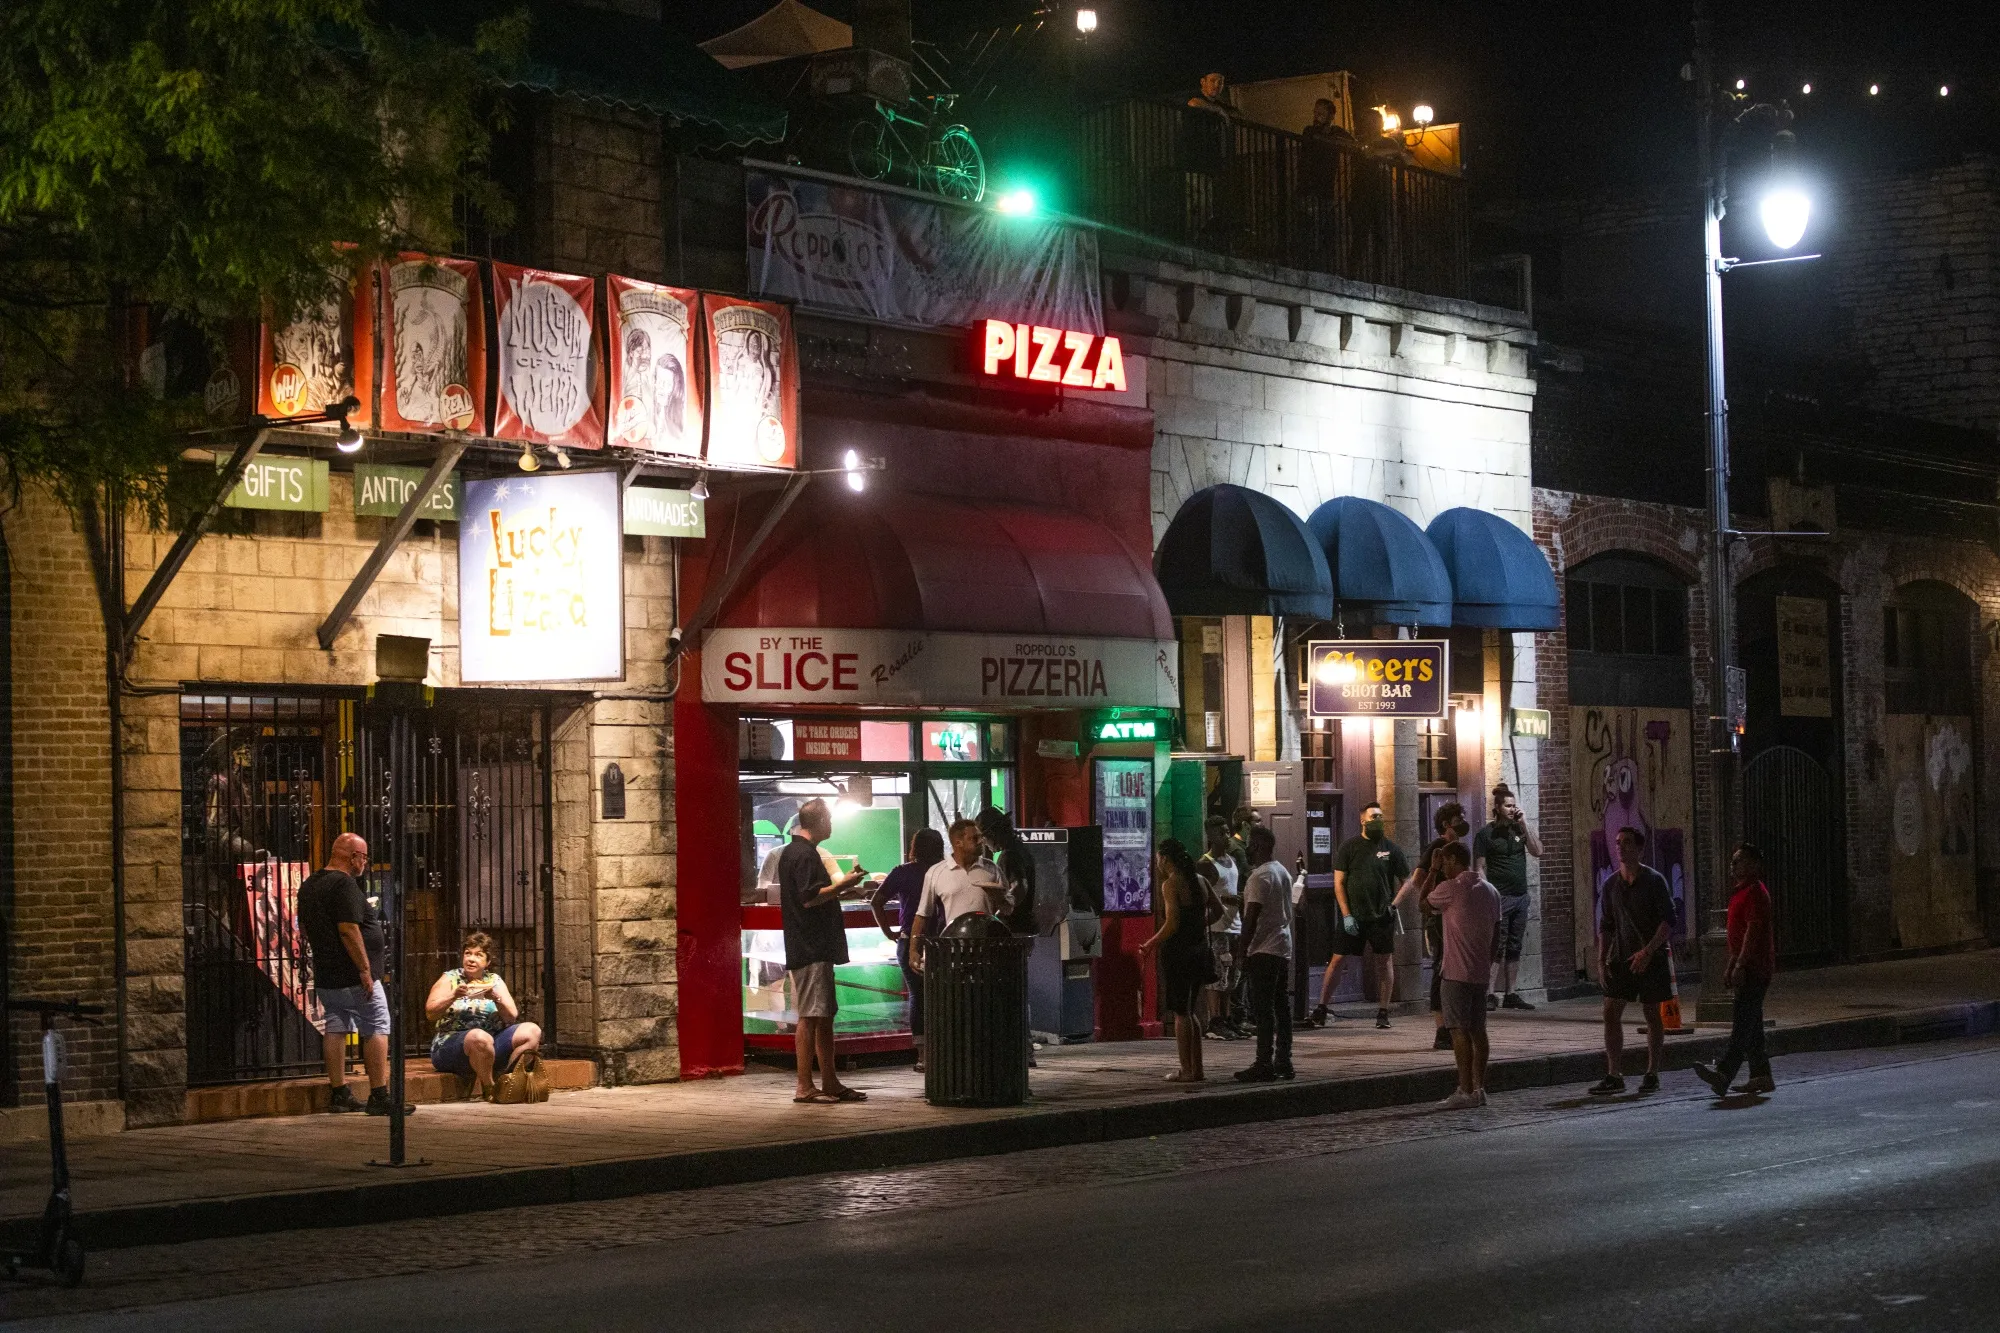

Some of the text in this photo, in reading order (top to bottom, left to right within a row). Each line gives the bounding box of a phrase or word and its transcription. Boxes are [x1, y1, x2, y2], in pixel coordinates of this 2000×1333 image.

[507, 273, 584, 359] MUSEUM
[516, 357, 575, 373] OF THE
[983, 319, 1127, 392] PIZZA
[441, 393, 473, 418] REAL
[509, 374, 578, 433] WEIRD
[244, 463, 303, 503] GIFTS
[360, 476, 454, 510] ANTIQES
[624, 498, 698, 527] ANDMADES
[489, 507, 583, 568] Lucky
[760, 637, 823, 650] BY THE
[1015, 643, 1076, 657] ROPPOLO'S
[724, 651, 859, 691] SLICE
[871, 638, 924, 687] Rosalie
[981, 657, 1107, 697] PIZZERIA
[1341, 683, 1412, 698] SHOT BAR
[1358, 701, 1396, 710] EST 1993
[796, 726, 859, 740] WE TAKE ORDERS
[1100, 722, 1156, 739] ATM
[1513, 717, 1547, 734] ATM
[805, 742, 849, 756] INSIDE TOO!
[1103, 772, 1146, 798] WE LOVE
[1105, 810, 1147, 829] THANK YOU
[1030, 832, 1055, 841] ATM
